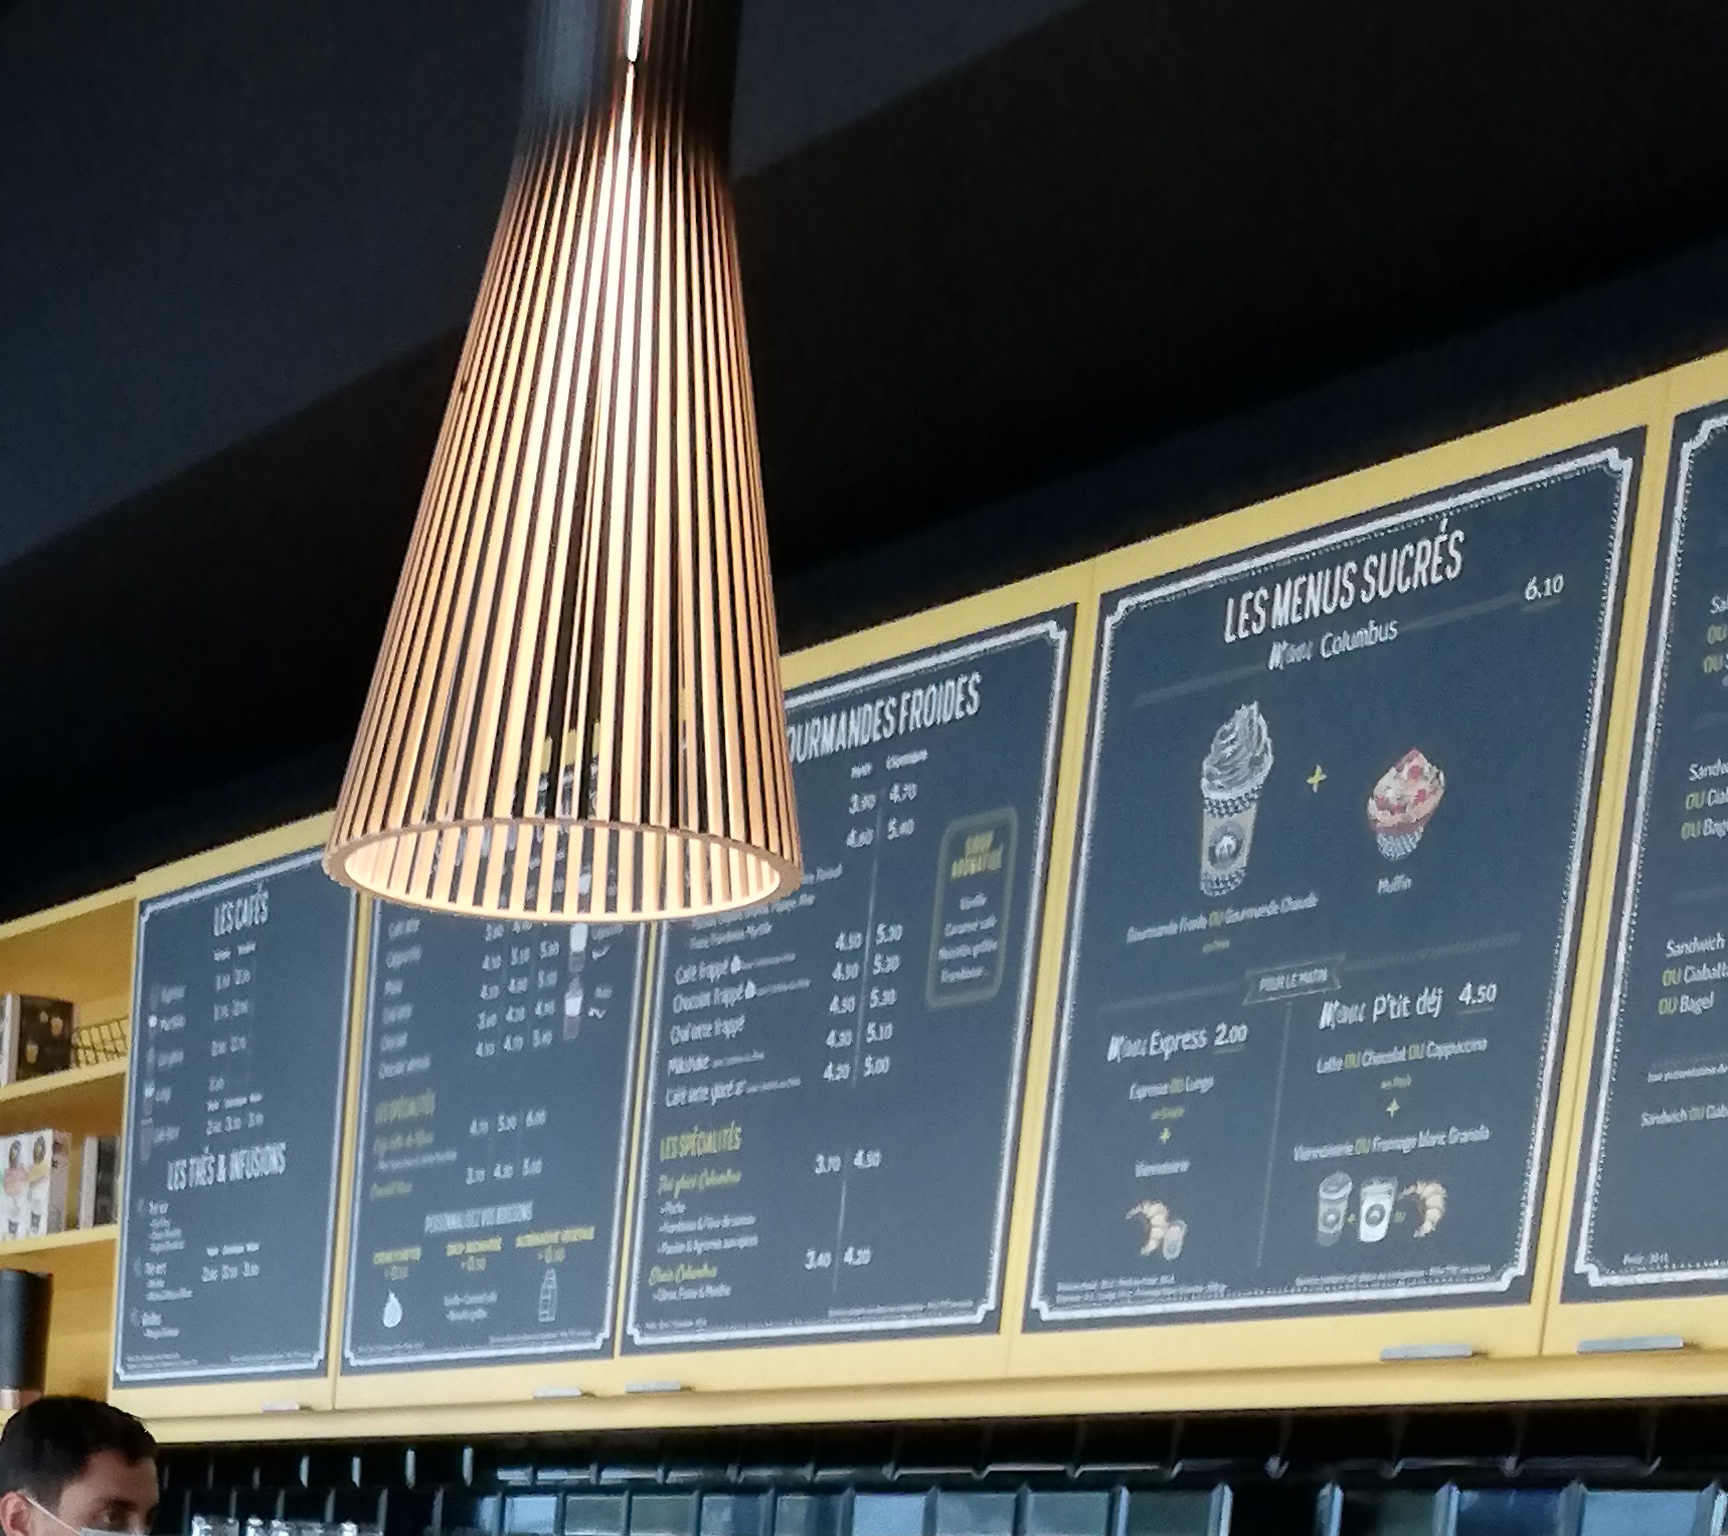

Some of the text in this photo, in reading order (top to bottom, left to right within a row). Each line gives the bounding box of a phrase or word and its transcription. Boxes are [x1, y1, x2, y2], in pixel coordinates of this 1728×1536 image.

[1224, 518, 1465, 643] LES MENUS SUCRÉS
[1524, 573, 1564, 601] 6.10
[1320, 618, 1399, 658] Columbus
[787, 671, 982, 764] OURMANDES FROIDES
[1458, 981, 1498, 1005] 4.50
[1149, 1028, 1208, 1061] Express
